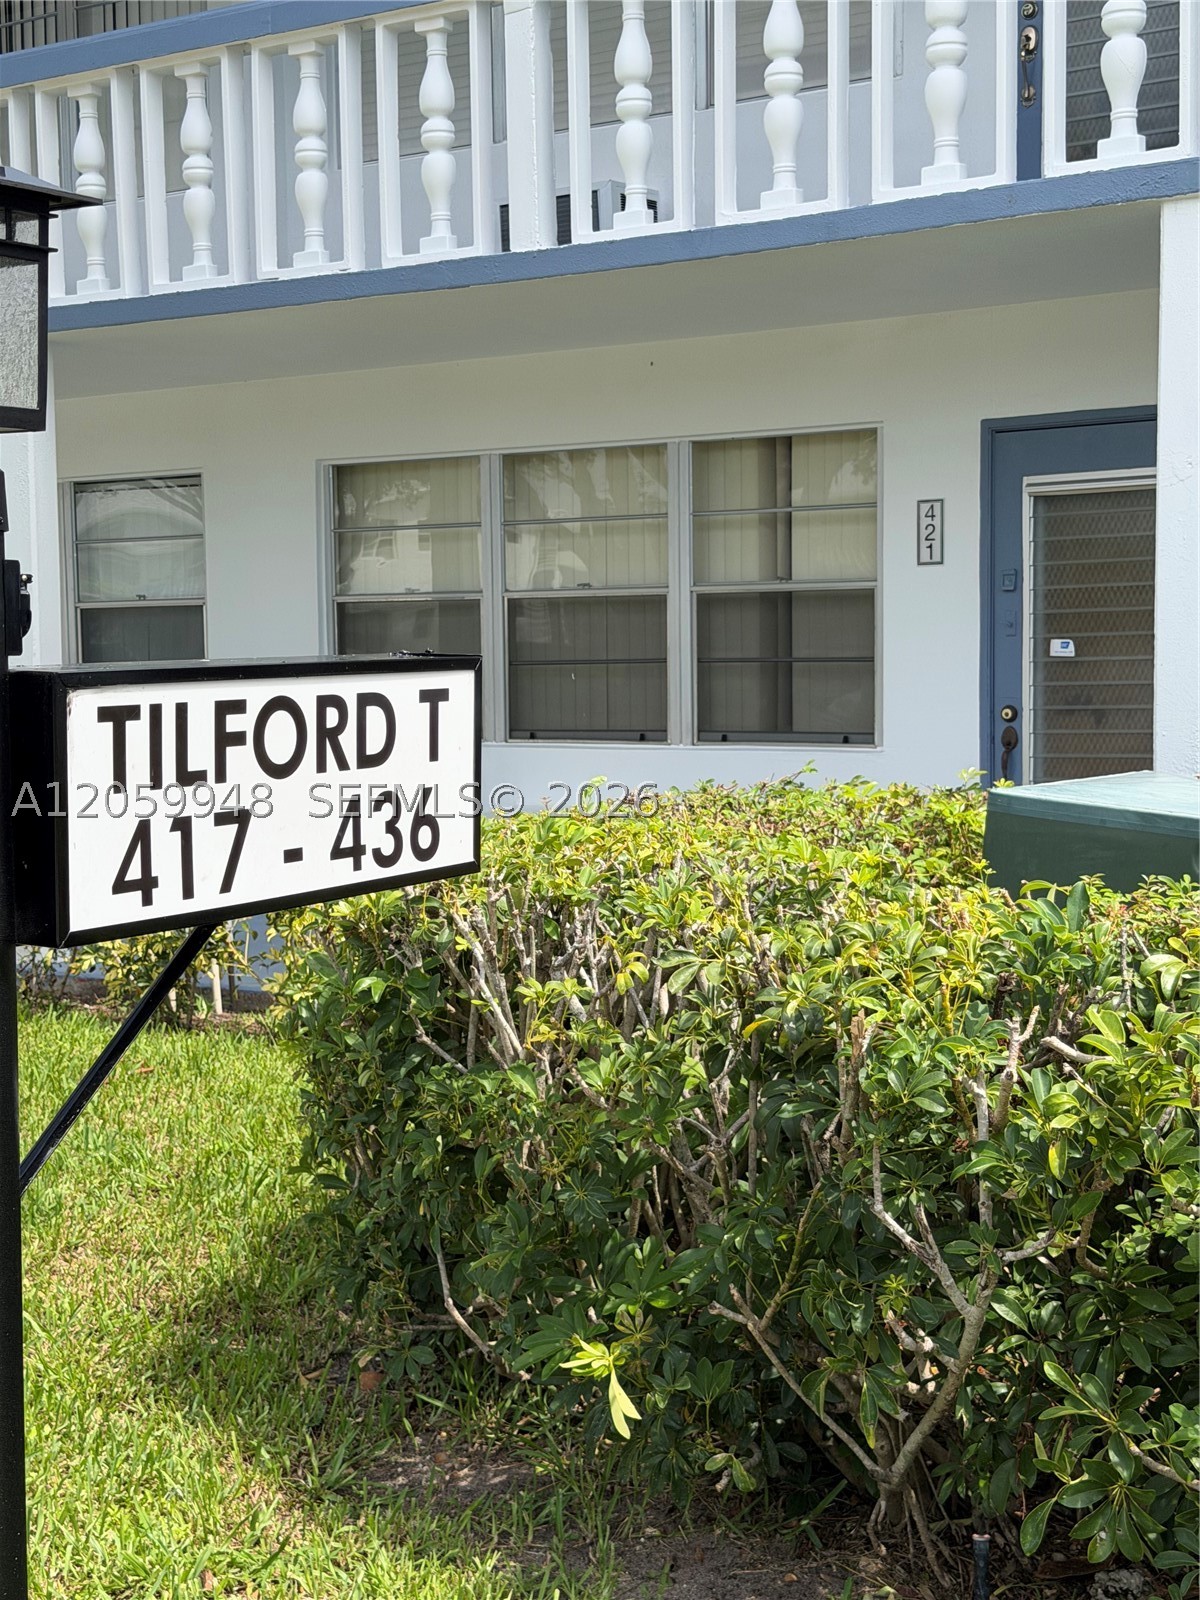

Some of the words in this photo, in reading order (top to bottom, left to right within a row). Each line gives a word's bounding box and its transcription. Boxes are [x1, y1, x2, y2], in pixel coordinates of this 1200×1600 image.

[924, 504, 936, 560] 421
[97, 691, 397, 794] TILFORD
[419, 688, 449, 762] T
[112, 808, 252, 907] 417
[283, 847, 303, 864] -
[330, 786, 440, 872] 436
